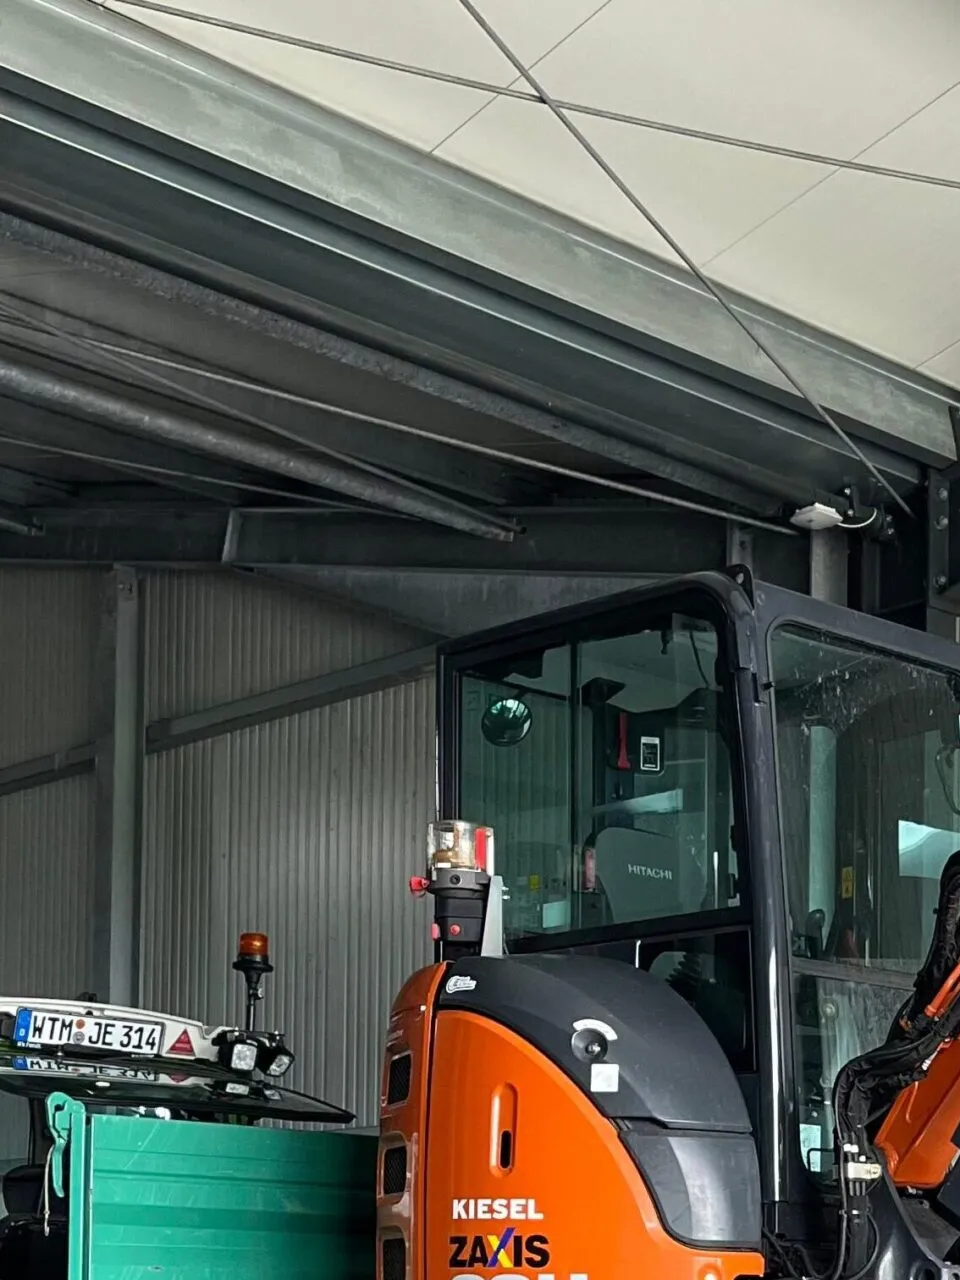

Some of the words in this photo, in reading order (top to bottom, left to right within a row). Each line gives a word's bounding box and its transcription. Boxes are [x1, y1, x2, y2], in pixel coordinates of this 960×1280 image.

[628, 863, 673, 880] HITACHI
[32, 1015, 74, 1042] WTM
[88, 1022, 116, 1047] JE
[119, 1025, 157, 1051] 314
[452, 1198, 544, 1220] KIESEL
[449, 1227, 550, 1268] ZAXIS
